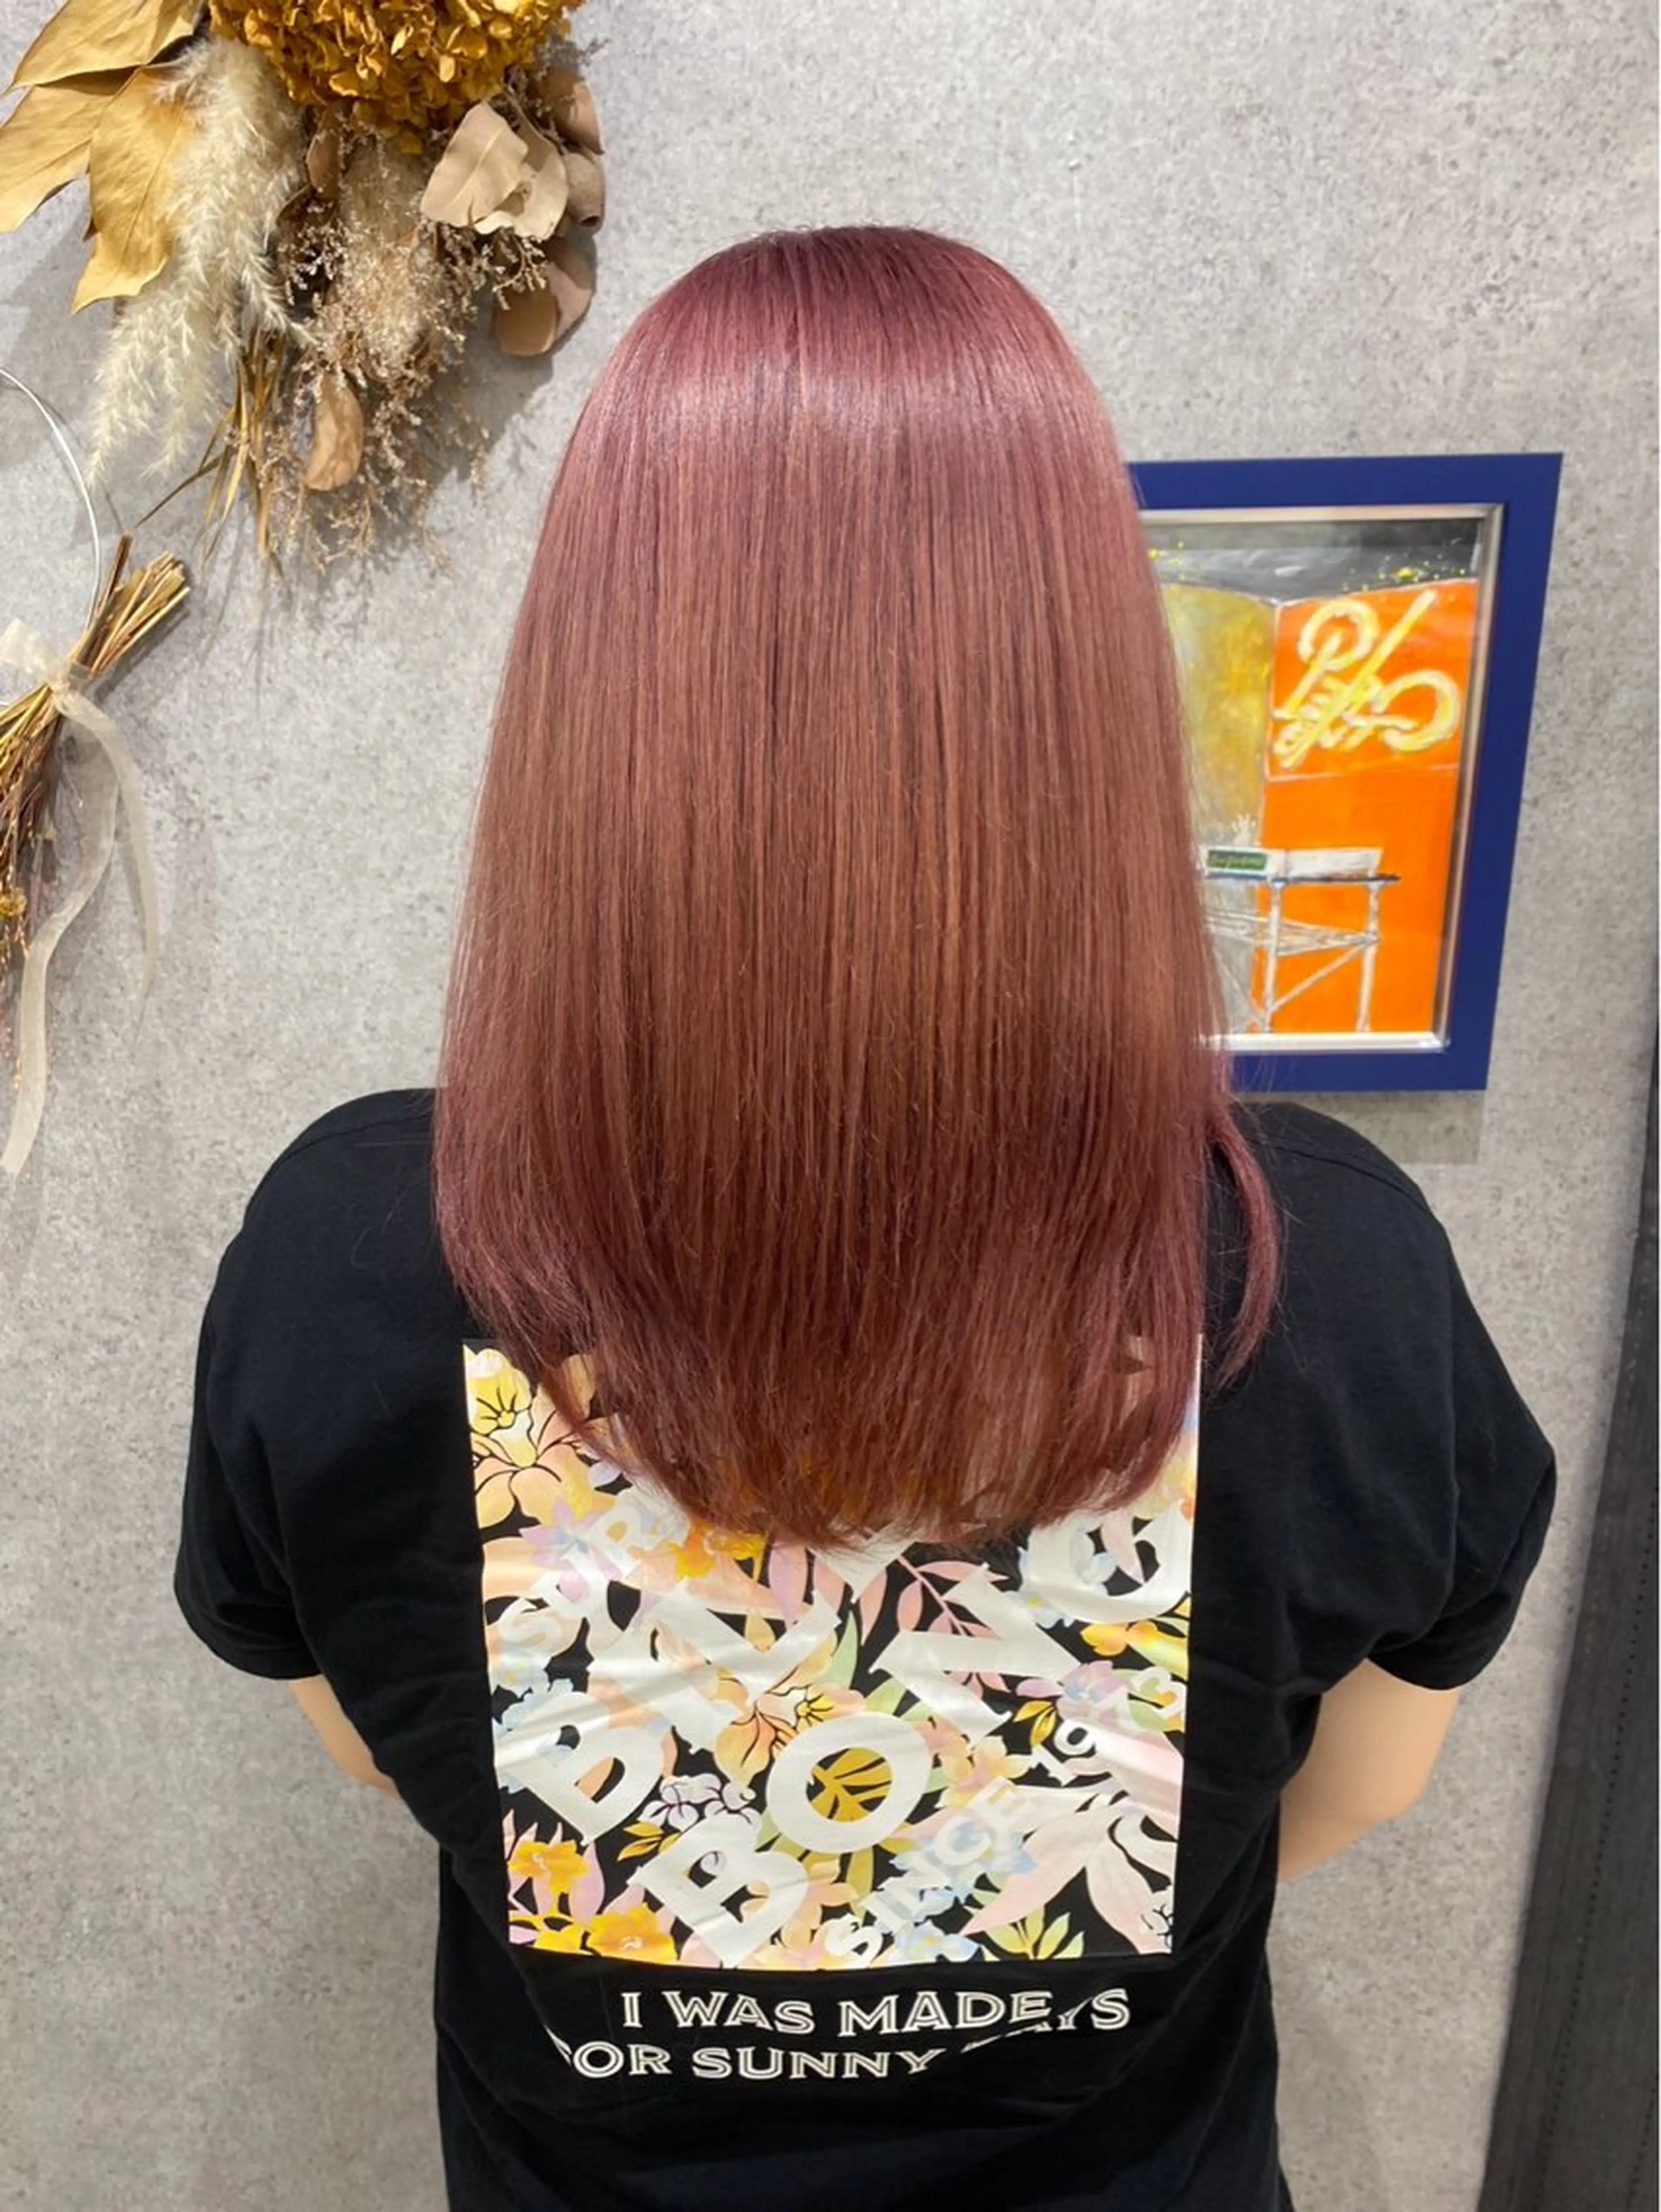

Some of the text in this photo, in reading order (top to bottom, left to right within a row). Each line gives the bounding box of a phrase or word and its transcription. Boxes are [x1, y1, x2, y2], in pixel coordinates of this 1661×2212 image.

[499, 1494, 681, 1651] SUR
[626, 1501, 1192, 1968] BONG
[824, 1666, 1185, 1968] SINCE 1973
[544, 2024, 673, 2079] OR
[692, 2046, 946, 2080] SUNNY
[621, 1991, 1053, 2038] I WAS MADE
